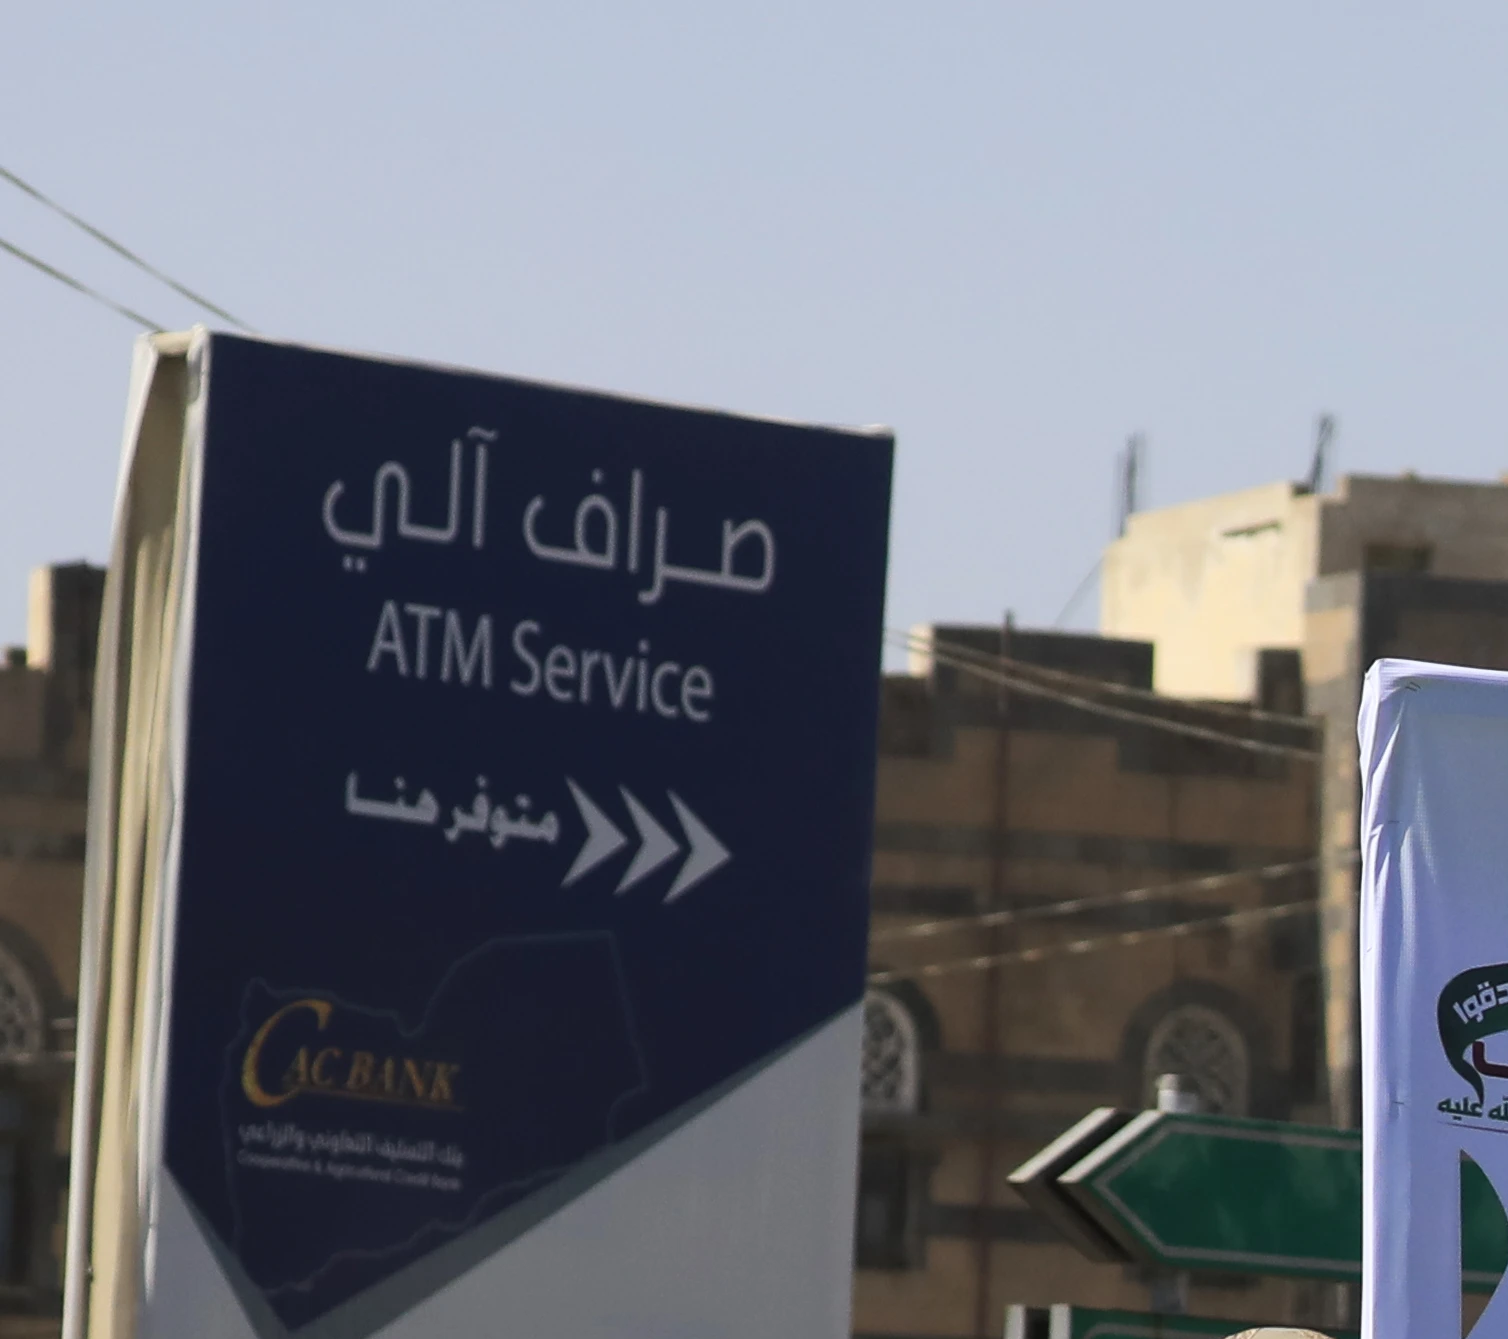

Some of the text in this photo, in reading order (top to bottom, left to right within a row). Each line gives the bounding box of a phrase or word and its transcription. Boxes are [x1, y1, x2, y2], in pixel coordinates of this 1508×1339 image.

[323, 428, 777, 604] صراف آلي
[367, 602, 715, 722] ATM Service
[345, 772, 560, 849] متوفر هنا
[347, 1051, 460, 1101] BANK
[1437, 1097, 1483, 1121] عليه
